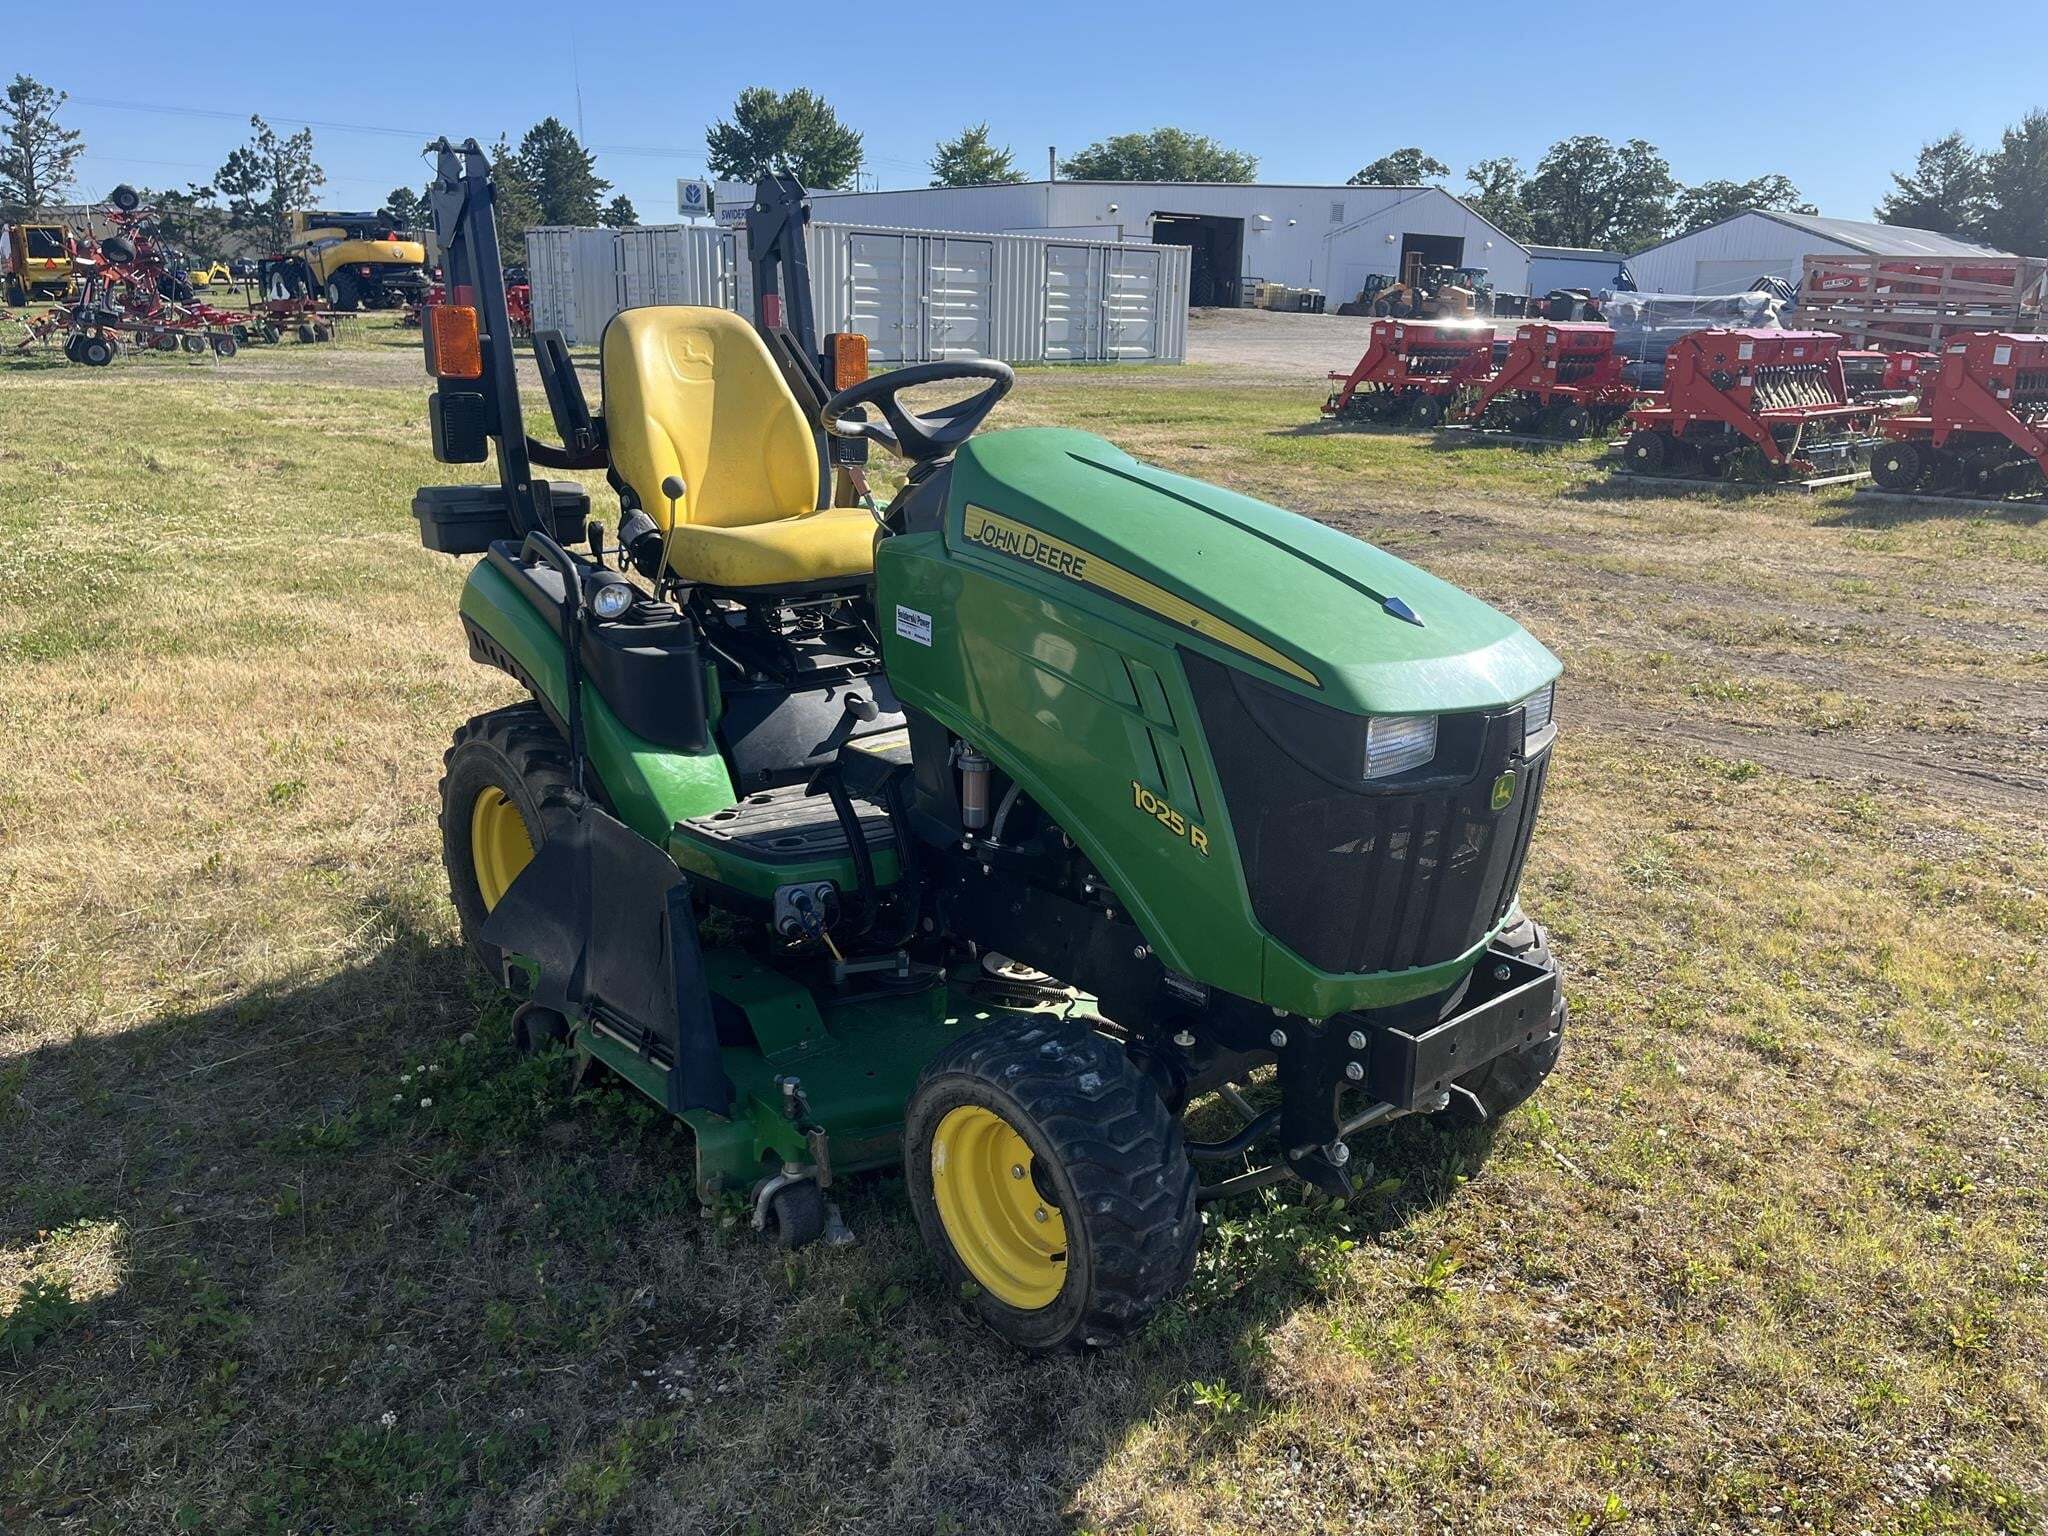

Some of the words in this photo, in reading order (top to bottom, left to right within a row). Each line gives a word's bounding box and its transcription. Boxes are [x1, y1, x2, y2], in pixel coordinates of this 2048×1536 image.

[973, 519, 1021, 553] JOHN
[1022, 533, 1087, 578] DEERE
[1132, 780, 1186, 836] 1025
[1190, 824, 1209, 857] R
